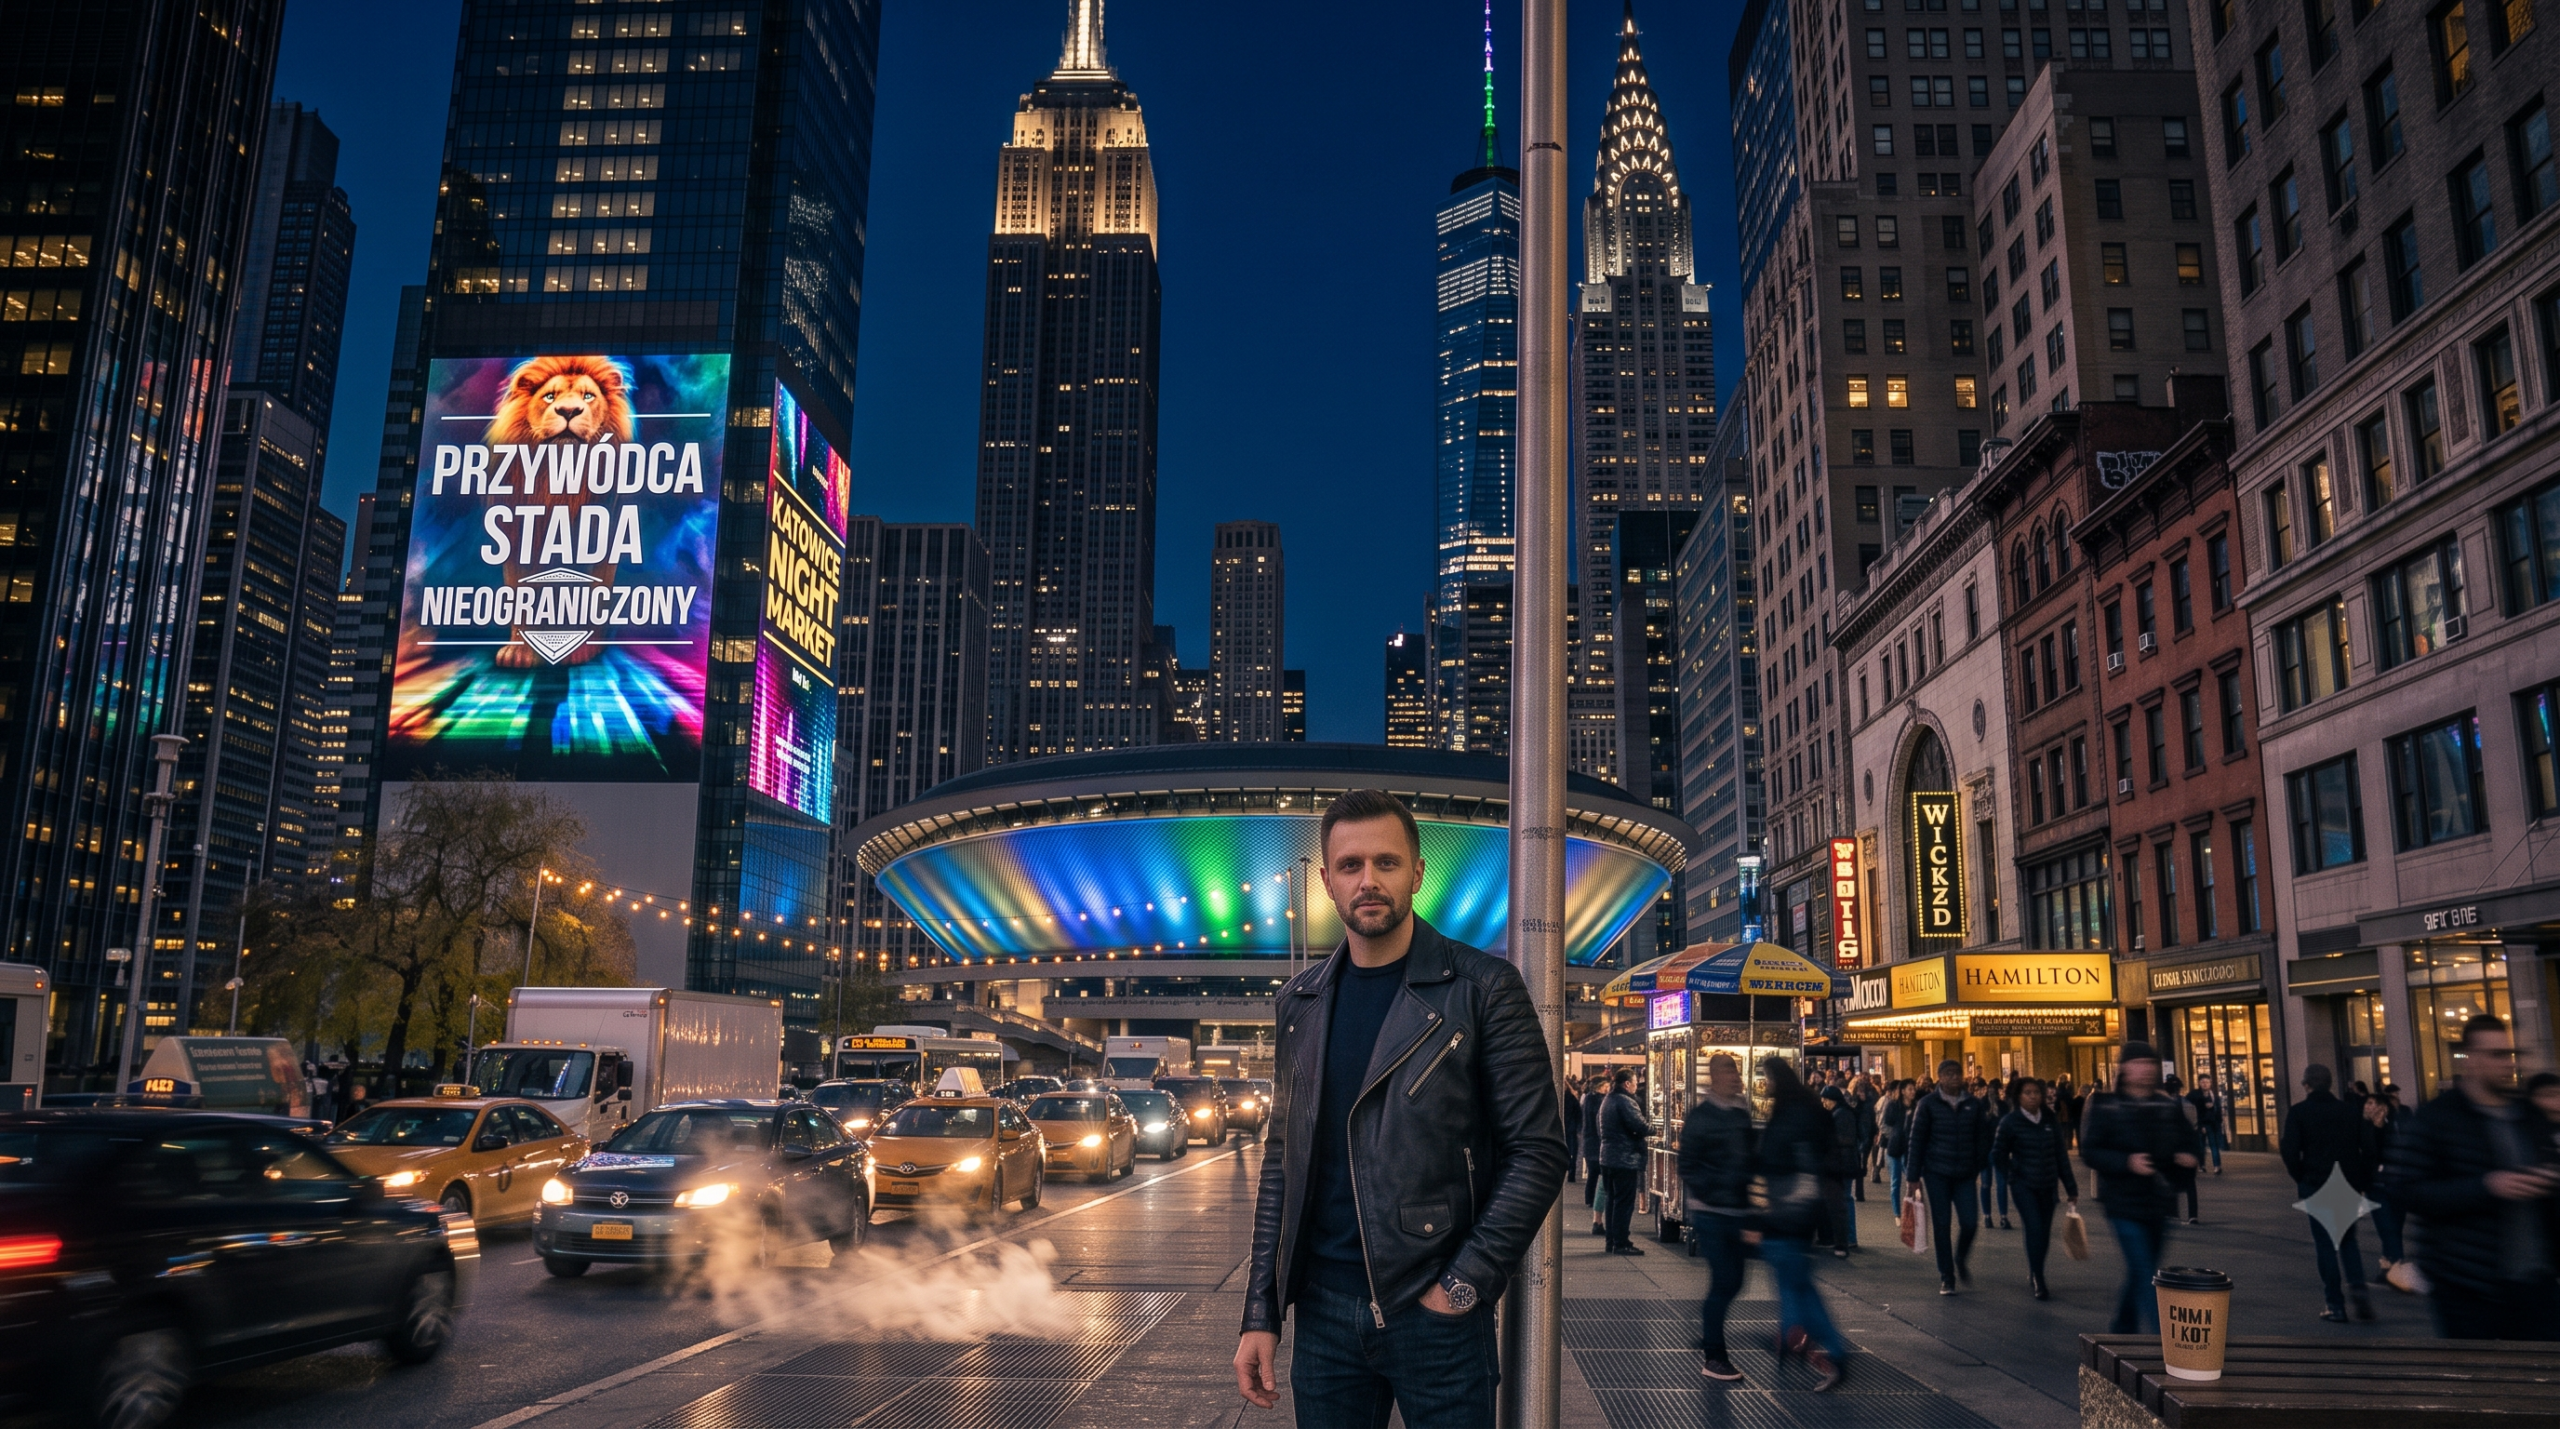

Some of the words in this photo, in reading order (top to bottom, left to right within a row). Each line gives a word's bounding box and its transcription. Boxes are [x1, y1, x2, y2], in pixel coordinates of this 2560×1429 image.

[431, 433, 704, 495] PRZYWÓDCA
[480, 504, 643, 565] STADA
[771, 490, 842, 588] KATOWICE
[420, 585, 697, 626] NIEOGRANICZONY
[768, 530, 839, 630] NIGHT
[766, 582, 835, 669] MARKET
[1922, 804, 1952, 926] WICKZD
[1965, 967, 2101, 985] HAMILTON
[2181, 1325, 2211, 1344] KOT
